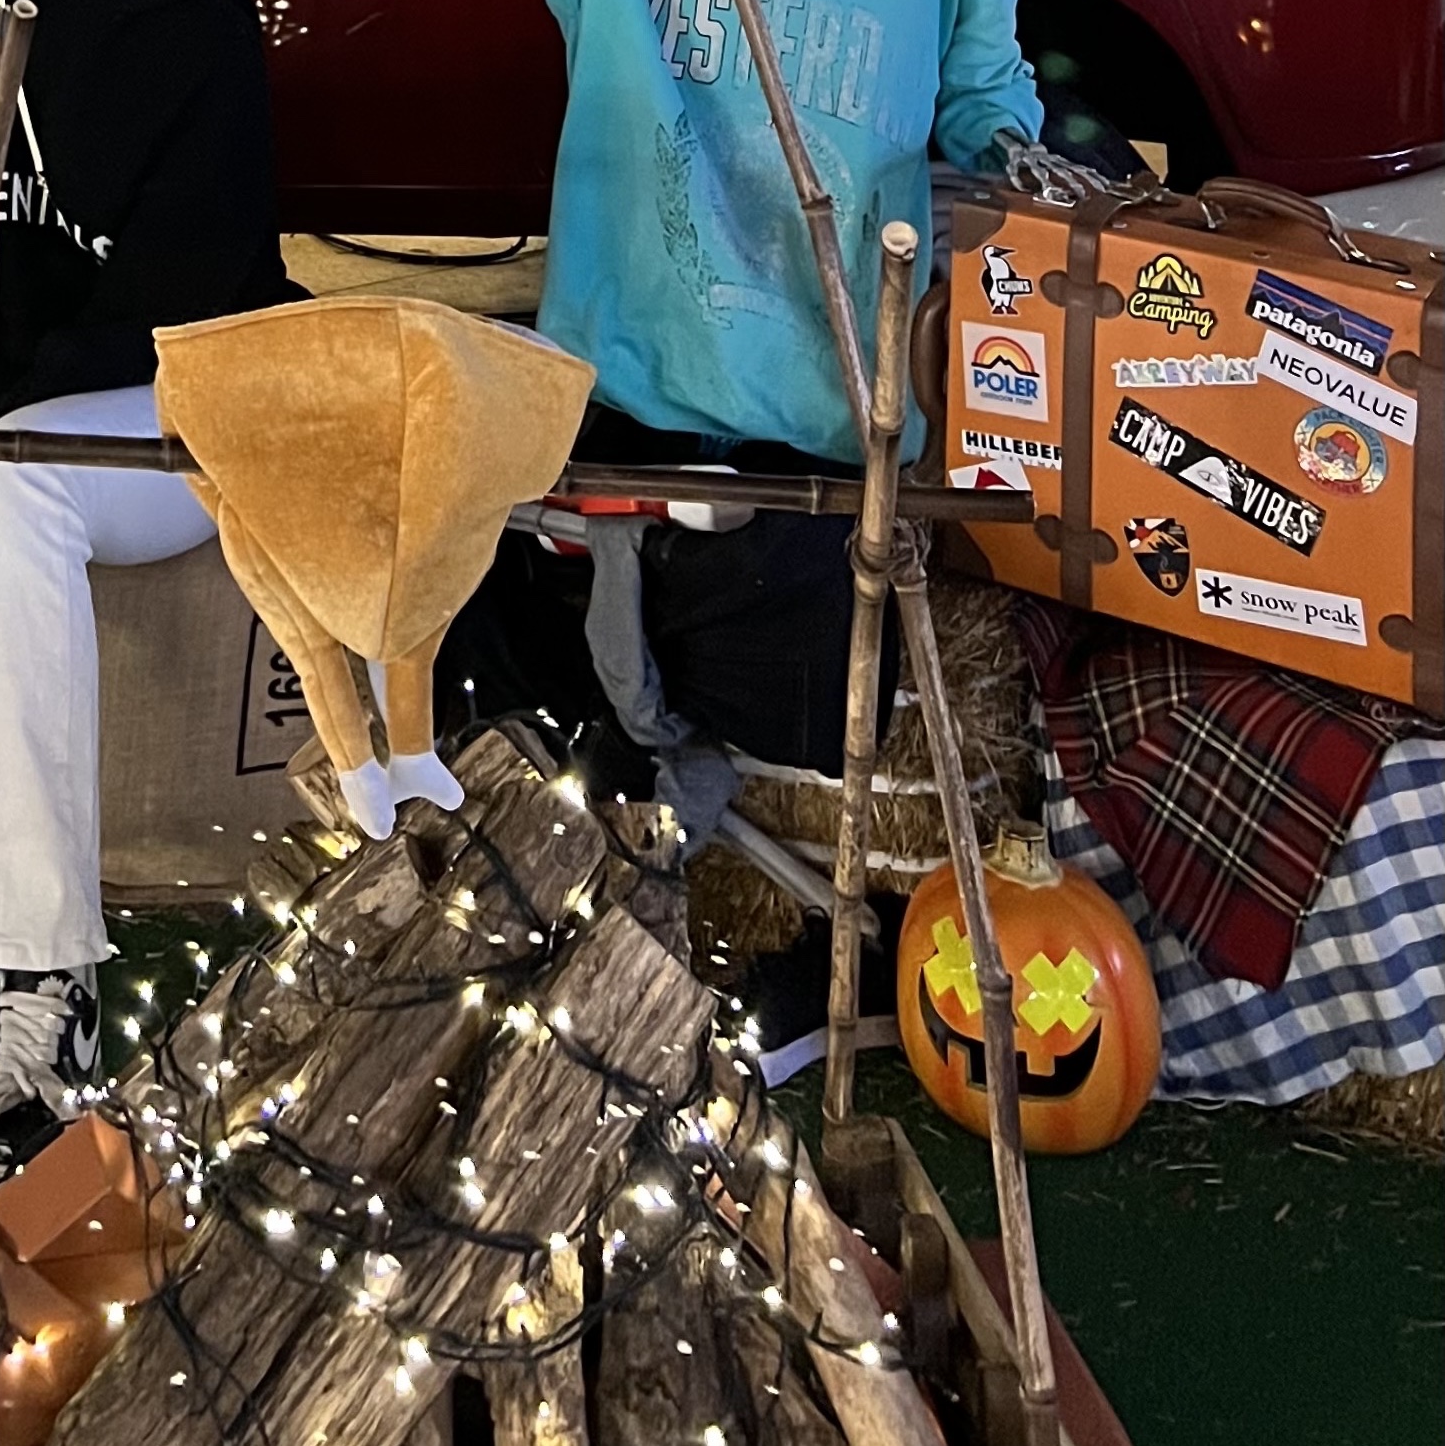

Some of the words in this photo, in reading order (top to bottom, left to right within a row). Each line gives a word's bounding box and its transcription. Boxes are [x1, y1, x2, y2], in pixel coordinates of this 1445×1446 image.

[997, 279, 1030, 294] CHUMS
[1130, 293, 1214, 337] Camping
[1252, 300, 1376, 368] patagonia
[973, 369, 1038, 399] POLER
[1269, 348, 1407, 427] NEOVALUE
[1118, 409, 1186, 467] CAMP
[1241, 477, 1317, 546] VIBES
[1240, 590, 1298, 614] snow
[1304, 604, 1360, 627] peak
